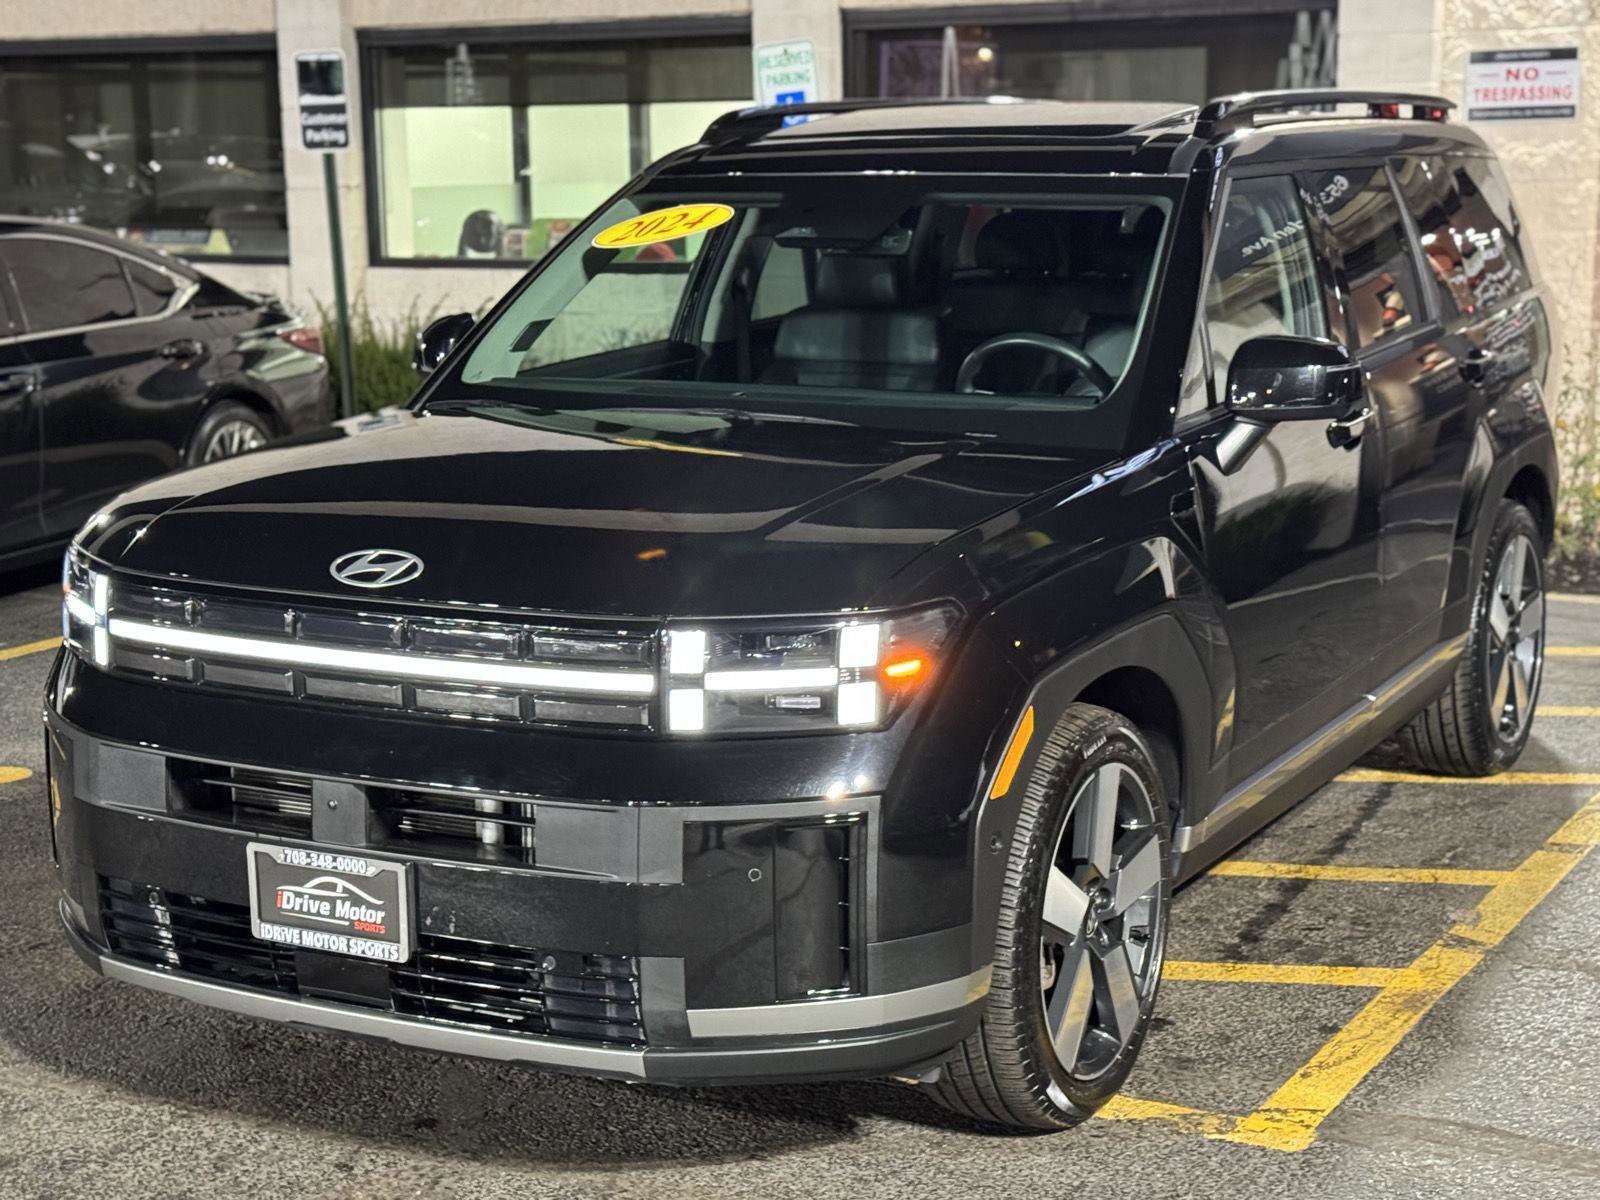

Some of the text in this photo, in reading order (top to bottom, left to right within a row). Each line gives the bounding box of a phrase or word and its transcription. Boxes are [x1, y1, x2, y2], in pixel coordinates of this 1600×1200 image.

[766, 69, 811, 85] PARKING
[1505, 67, 1539, 81] NO
[1474, 85, 1573, 102] TRESPASSING
[305, 128, 347, 145] Parking
[609, 207, 718, 244] 2024
[283, 848, 368, 875] 708-348-0000
[275, 889, 386, 925] iDrive Motor
[354, 920, 386, 934] SPORTS
[301, 930, 348, 952] MOTOR
[349, 938, 399, 960] SPORTS
